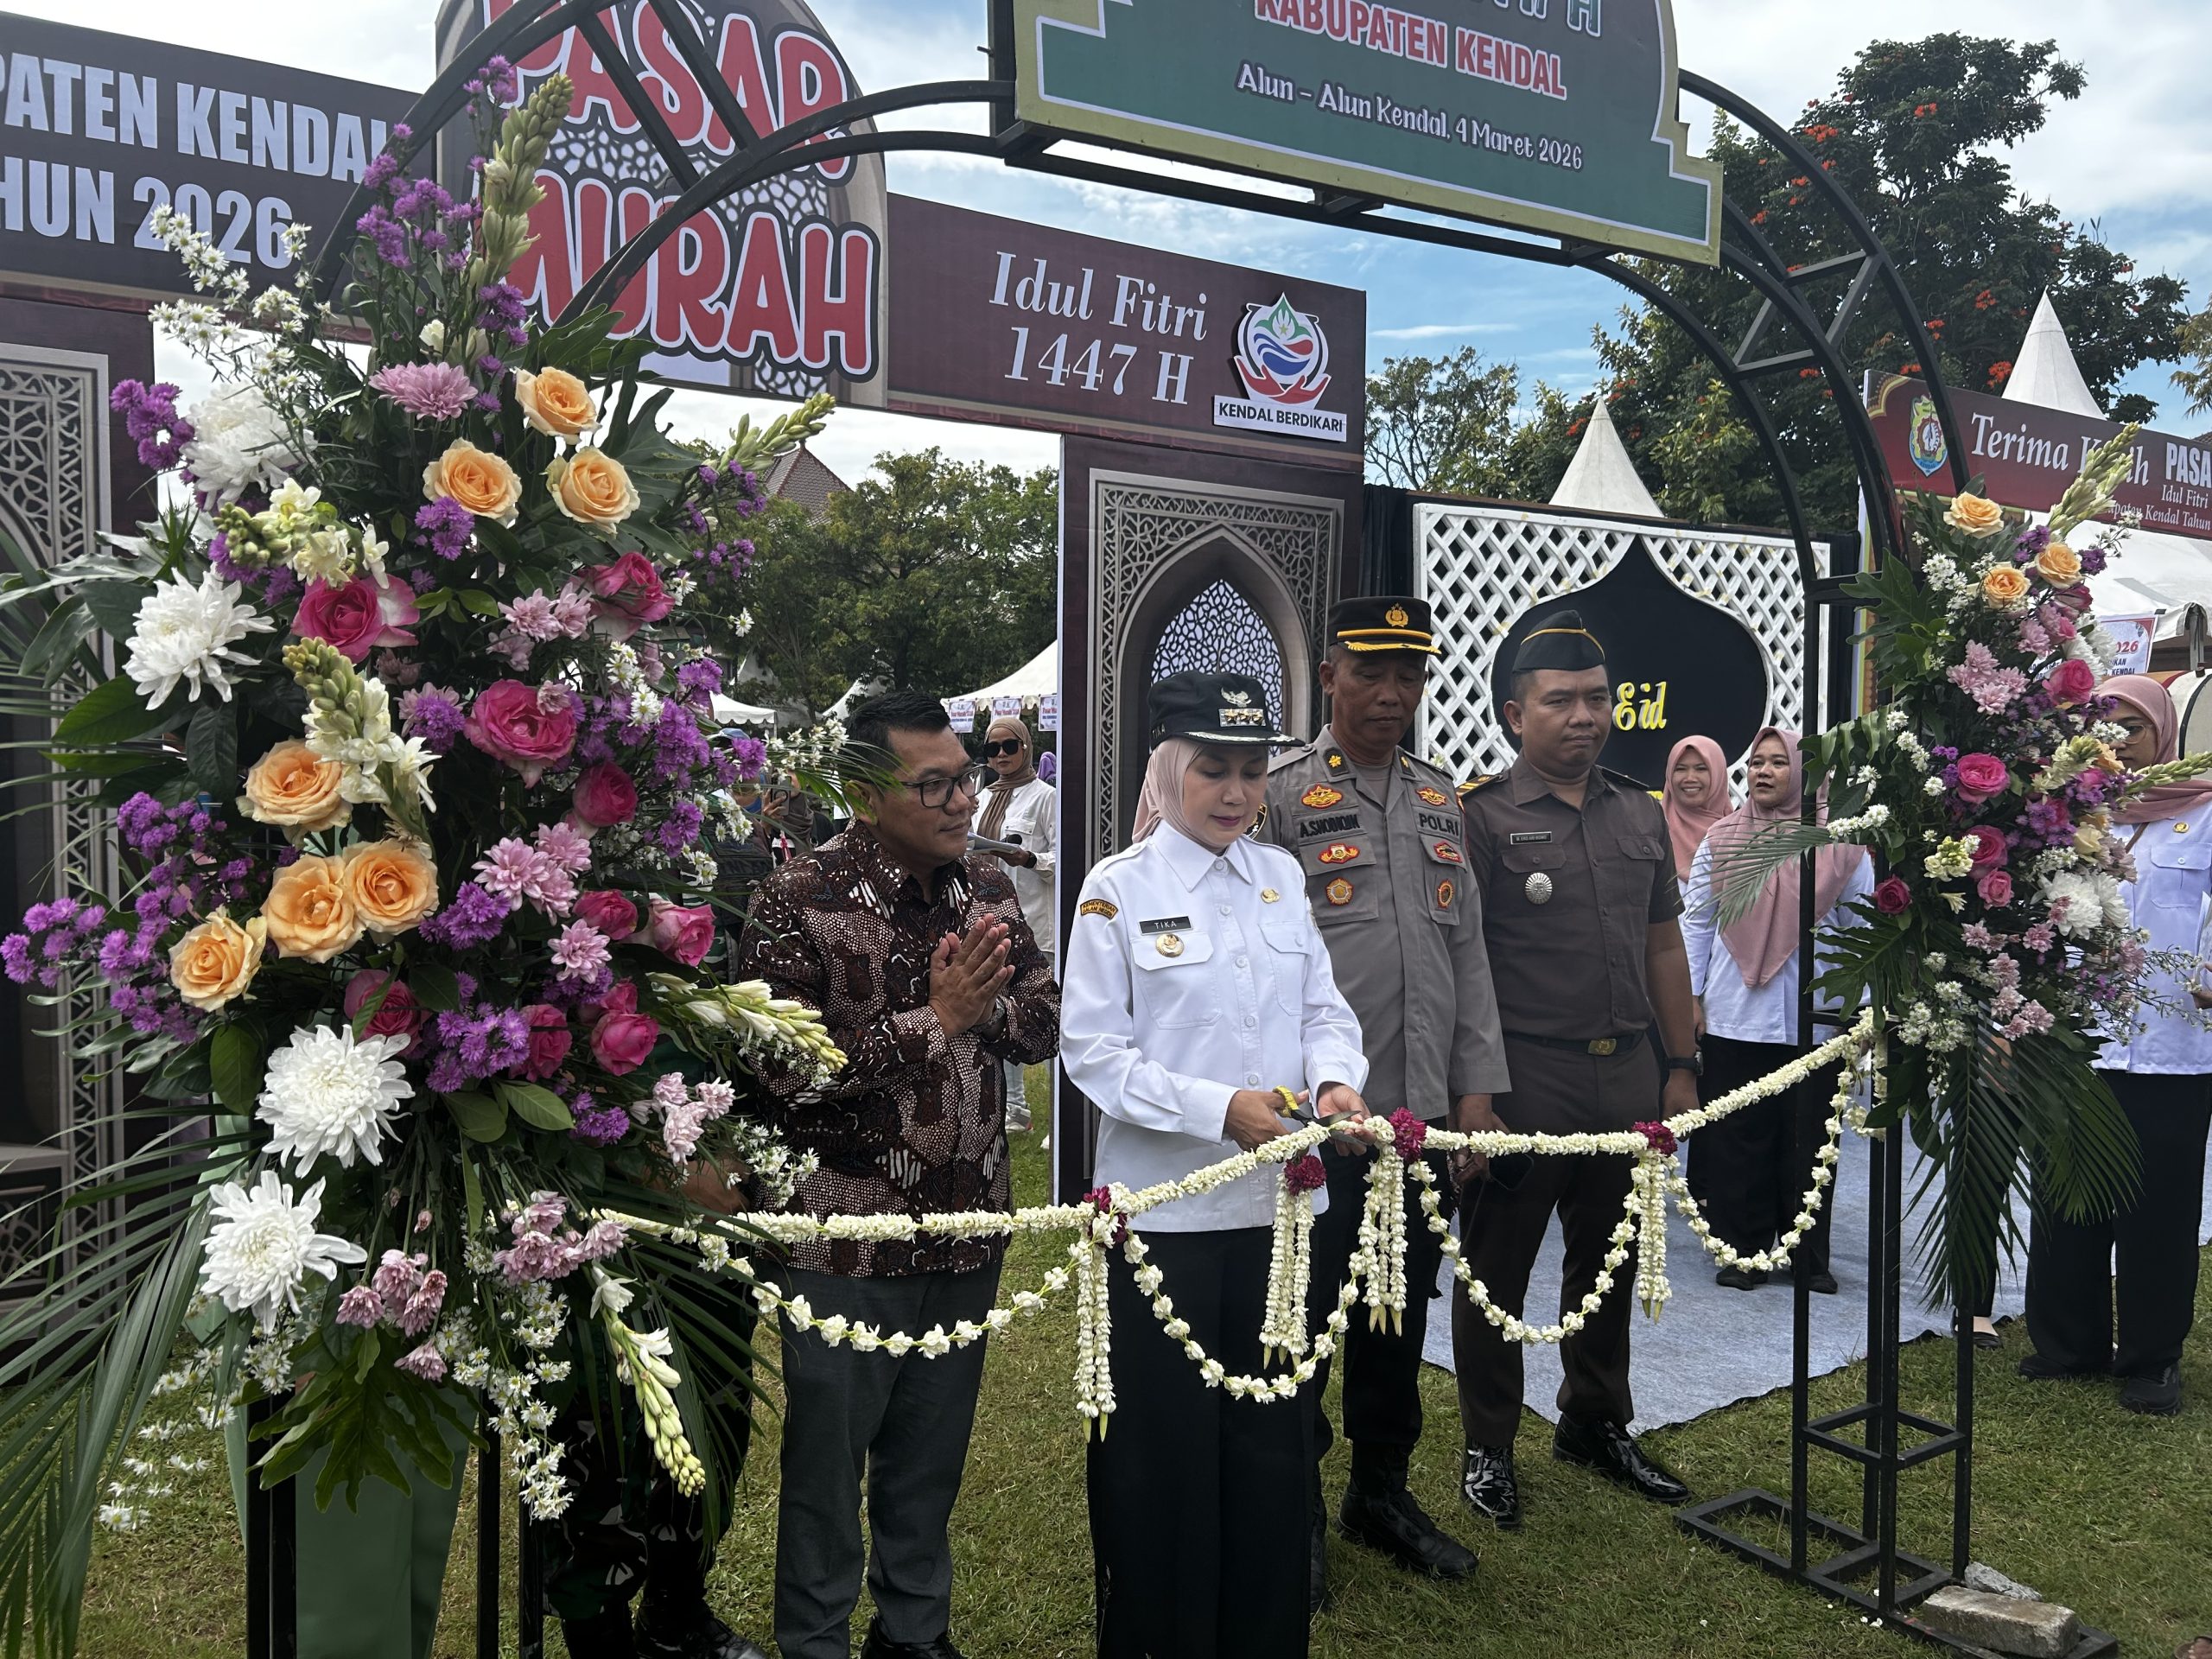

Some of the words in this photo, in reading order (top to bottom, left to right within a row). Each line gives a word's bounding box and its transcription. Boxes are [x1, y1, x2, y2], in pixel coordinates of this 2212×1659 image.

[1455, 27, 1567, 101] KENDAL
[0, 52, 158, 149] ATEN
[1237, 64, 1294, 101] Alun
[1319, 84, 1371, 119] Alun
[1377, 96, 1451, 140] Kendal,
[1456, 118, 1467, 143] 4
[1471, 120, 1534, 159] Maret
[1539, 138, 1583, 171] 2026
[134, 177, 292, 269] 2026
[988, 251, 1095, 321] Idul
[1109, 274, 1208, 341] Fitri
[1004, 327, 1139, 396] 1447
[1152, 351, 1194, 404] H
[1219, 403, 1274, 423] KENDAL
[1276, 410, 1343, 432] BERDIKARI
[1971, 411, 2069, 471] Terima
[2145, 504, 2180, 525] Kendal
[2183, 510, 2210, 531] Tahun
[2161, 484, 2183, 505] Idul
[2185, 489, 2209, 510] Fitri
[1612, 682, 1667, 731] Eid
[1419, 813, 1459, 836] POLRI
[1154, 920, 1177, 930] TIKA
